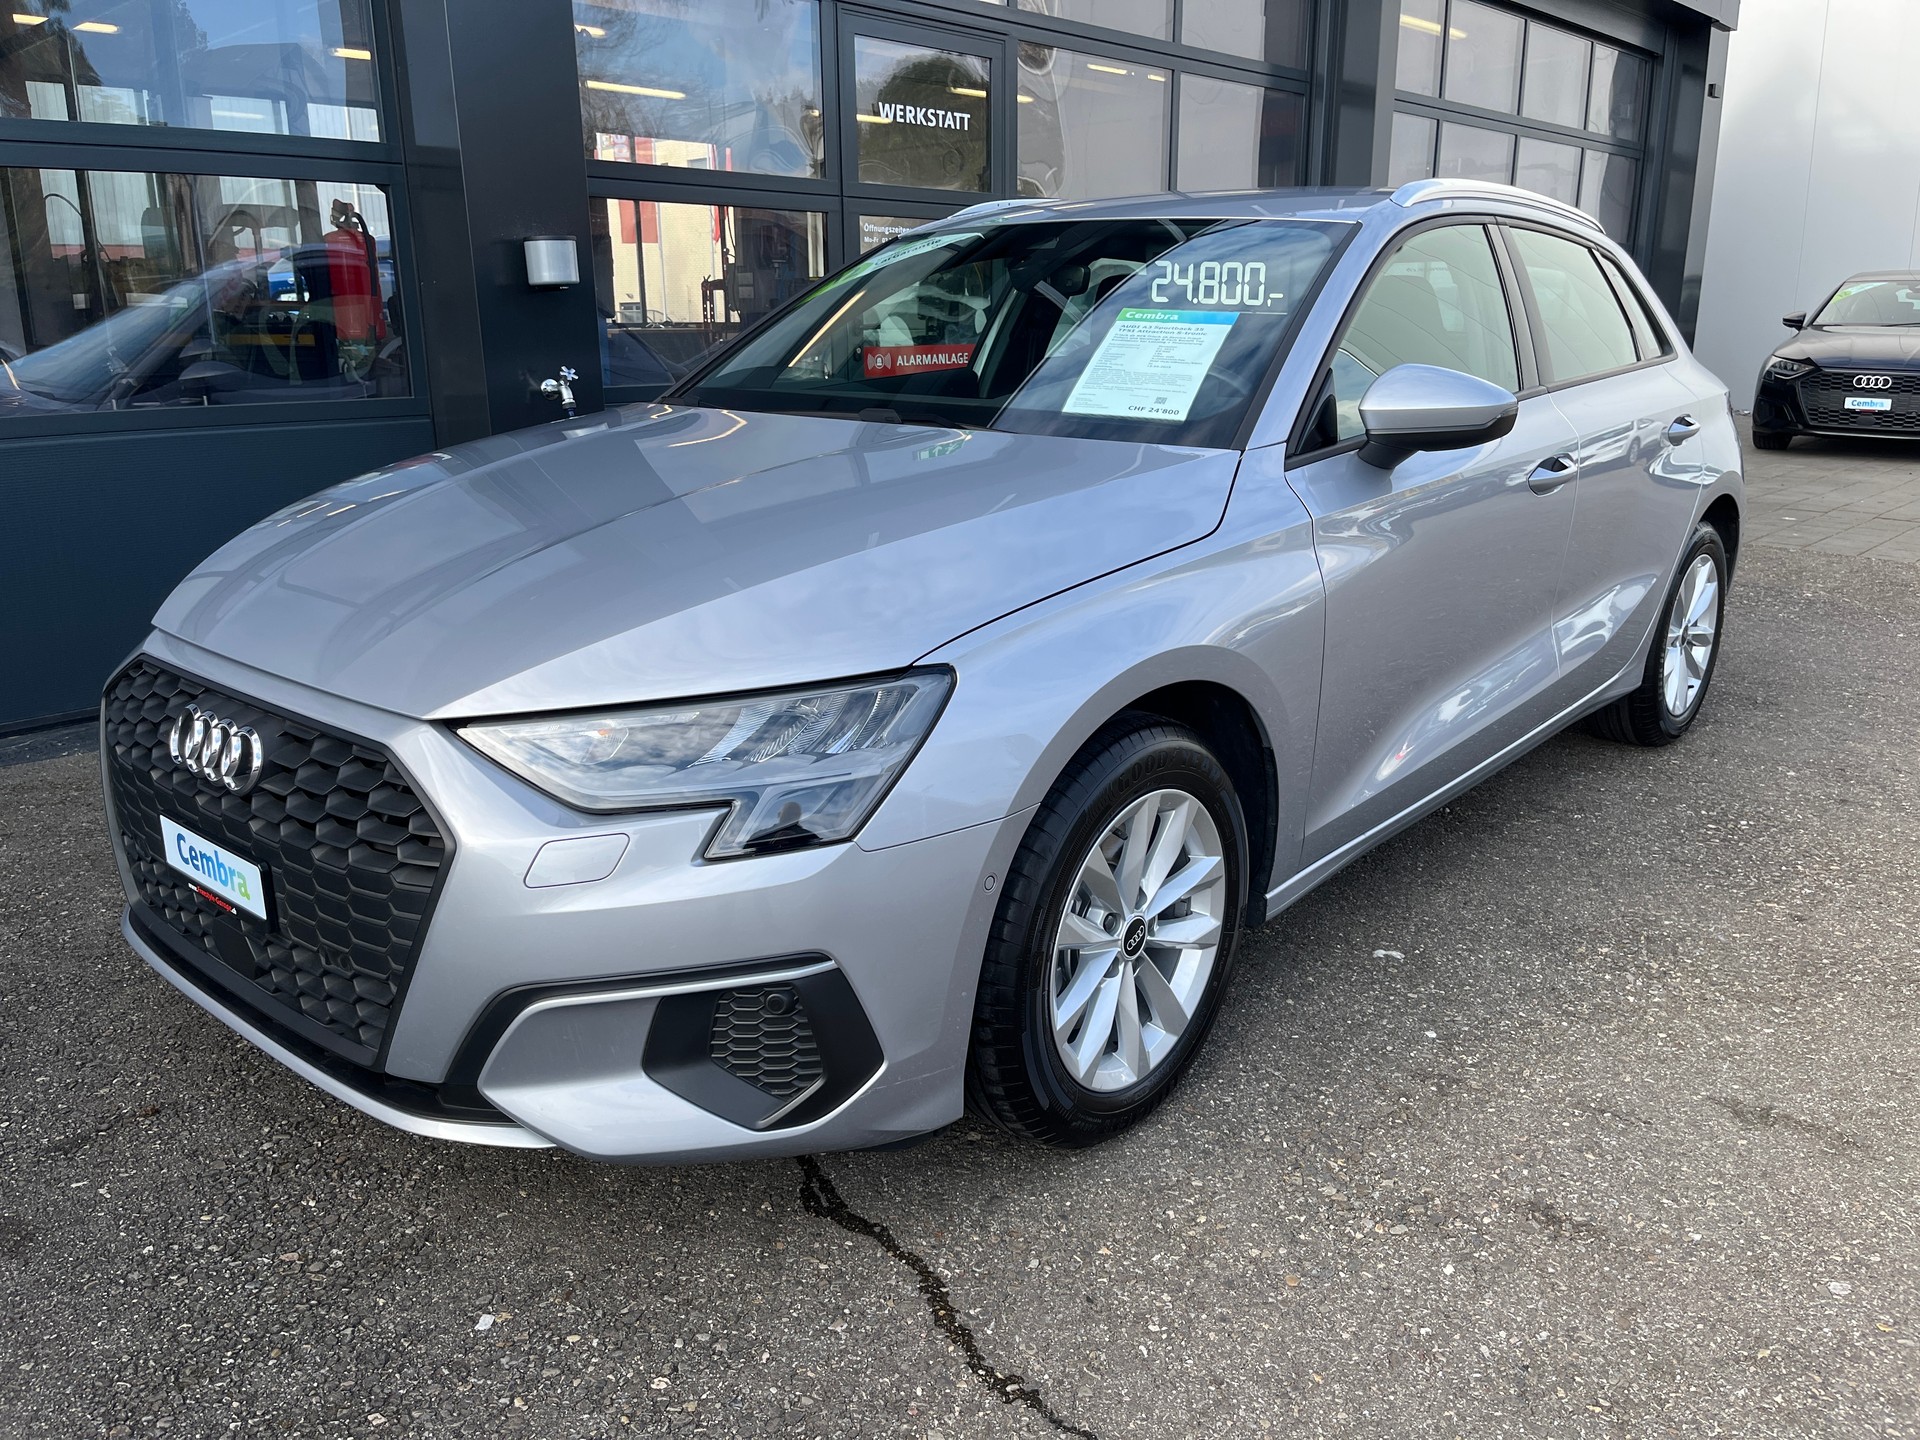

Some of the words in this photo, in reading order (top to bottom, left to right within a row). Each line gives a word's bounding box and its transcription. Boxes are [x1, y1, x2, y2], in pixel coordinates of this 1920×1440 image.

[878, 101, 971, 131] WERKSTATT
[1125, 311, 1179, 321] Cembra
[896, 352, 969, 367] ALARMANLAGE
[1851, 399, 1885, 408] Cembra
[1148, 407, 1180, 416] 24'800
[176, 832, 251, 901] Cembra
